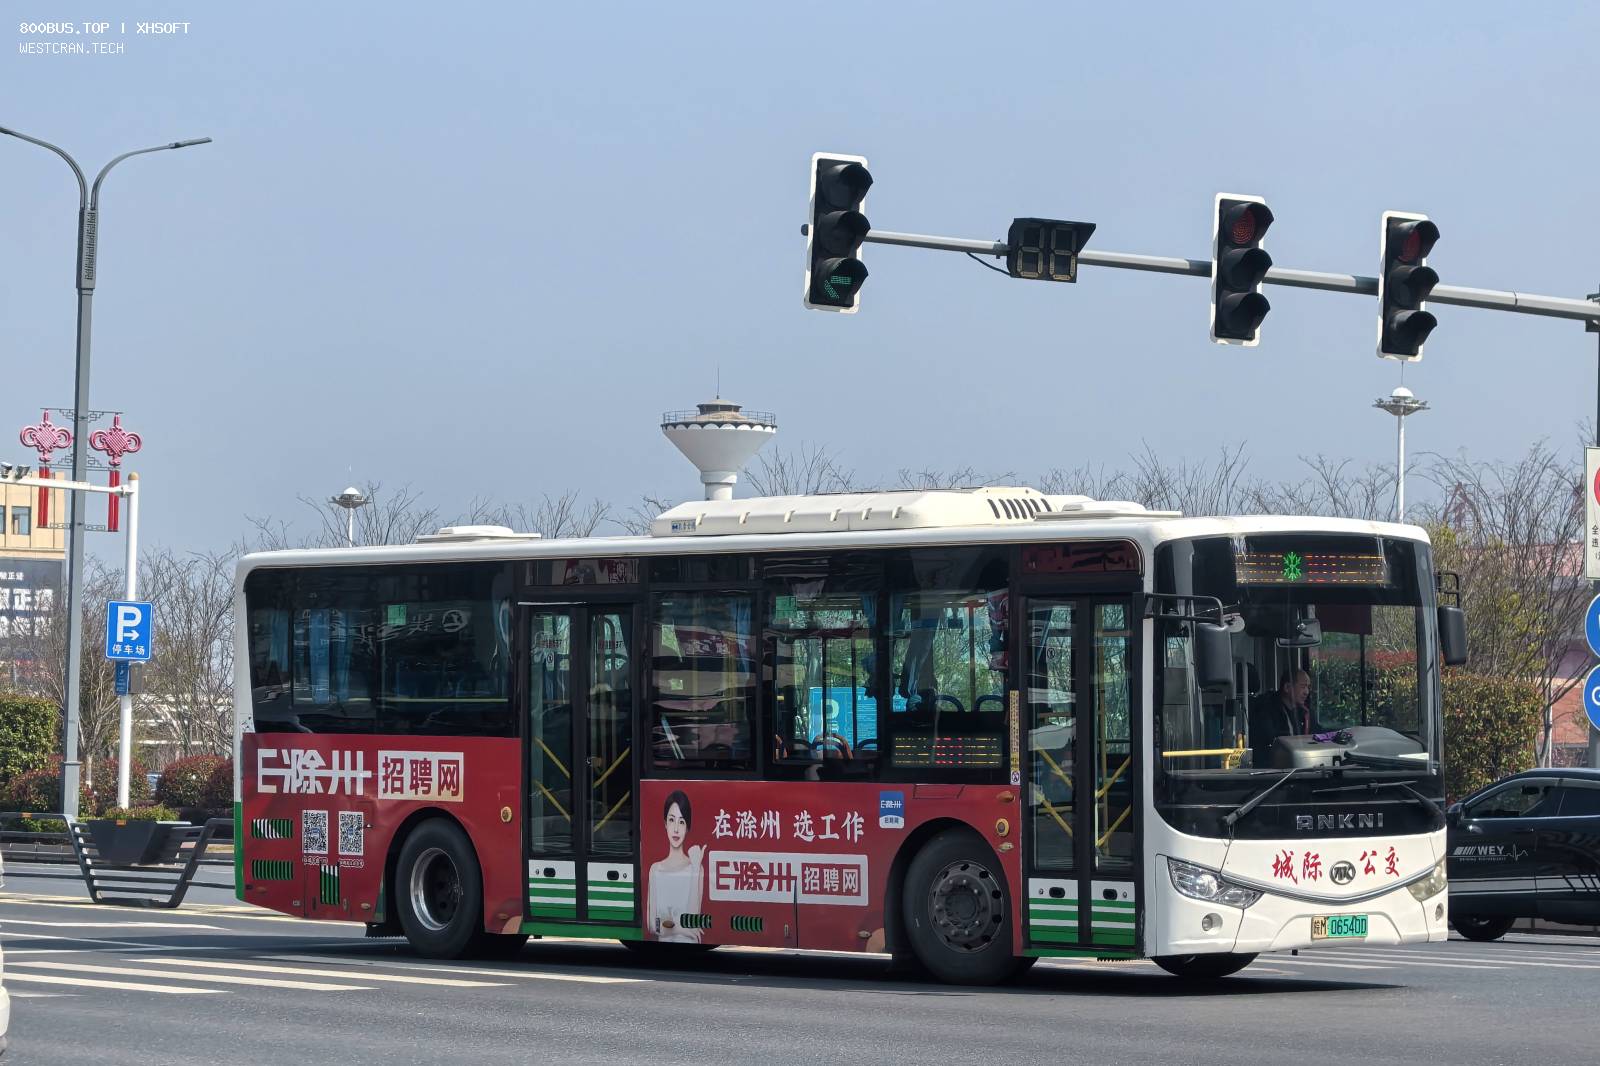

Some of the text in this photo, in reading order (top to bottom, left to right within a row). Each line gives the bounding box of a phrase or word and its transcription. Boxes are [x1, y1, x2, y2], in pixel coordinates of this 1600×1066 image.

[116, 605, 142, 643] P
[112, 643, 146, 656] 停车场
[382, 755, 460, 798] 招聘网
[711, 808, 865, 844] 在滁州 选工作
[1272, 846, 1400, 885] 城际 公交
[1477, 845, 1504, 855] WEY
[803, 865, 860, 895] 招聘网
